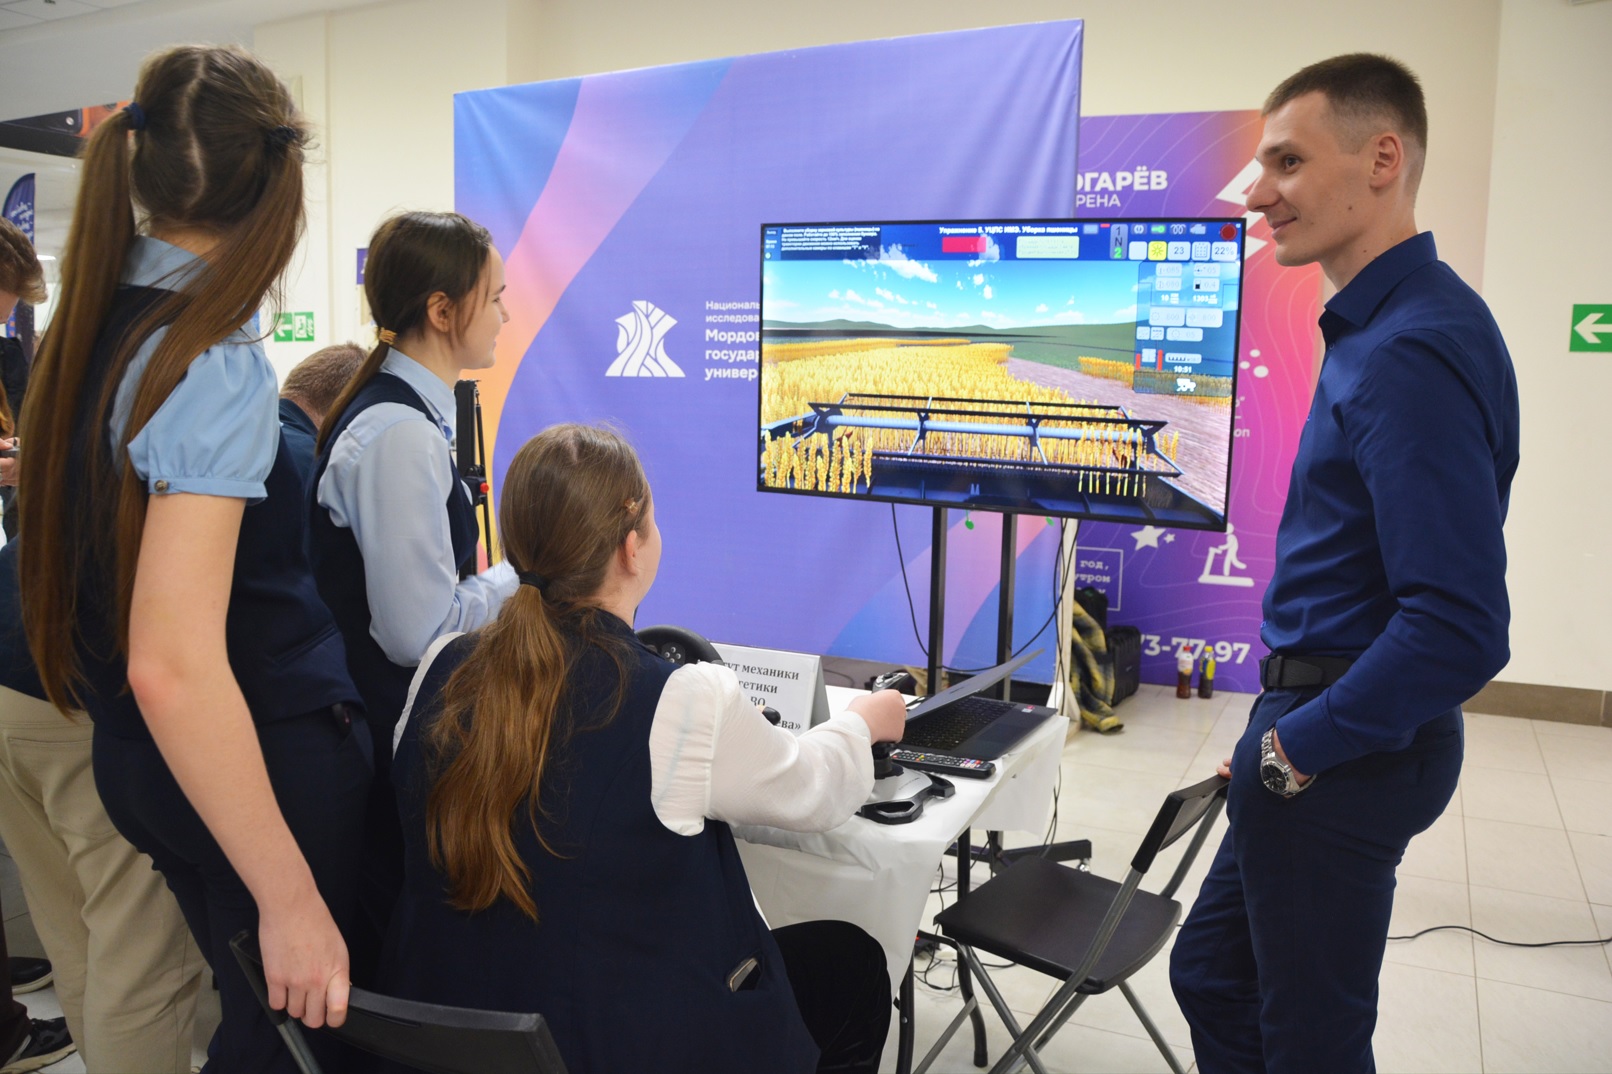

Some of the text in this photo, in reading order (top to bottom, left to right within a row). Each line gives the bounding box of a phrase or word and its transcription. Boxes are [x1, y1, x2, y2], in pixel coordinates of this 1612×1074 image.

[1115, 237, 1122, 246] N
[1114, 247, 1122, 259] 2
[1174, 246, 1185, 255] 23
[1215, 246, 1234, 255] 22%
[704, 368, 759, 381] универ
[742, 664, 800, 681] механики
